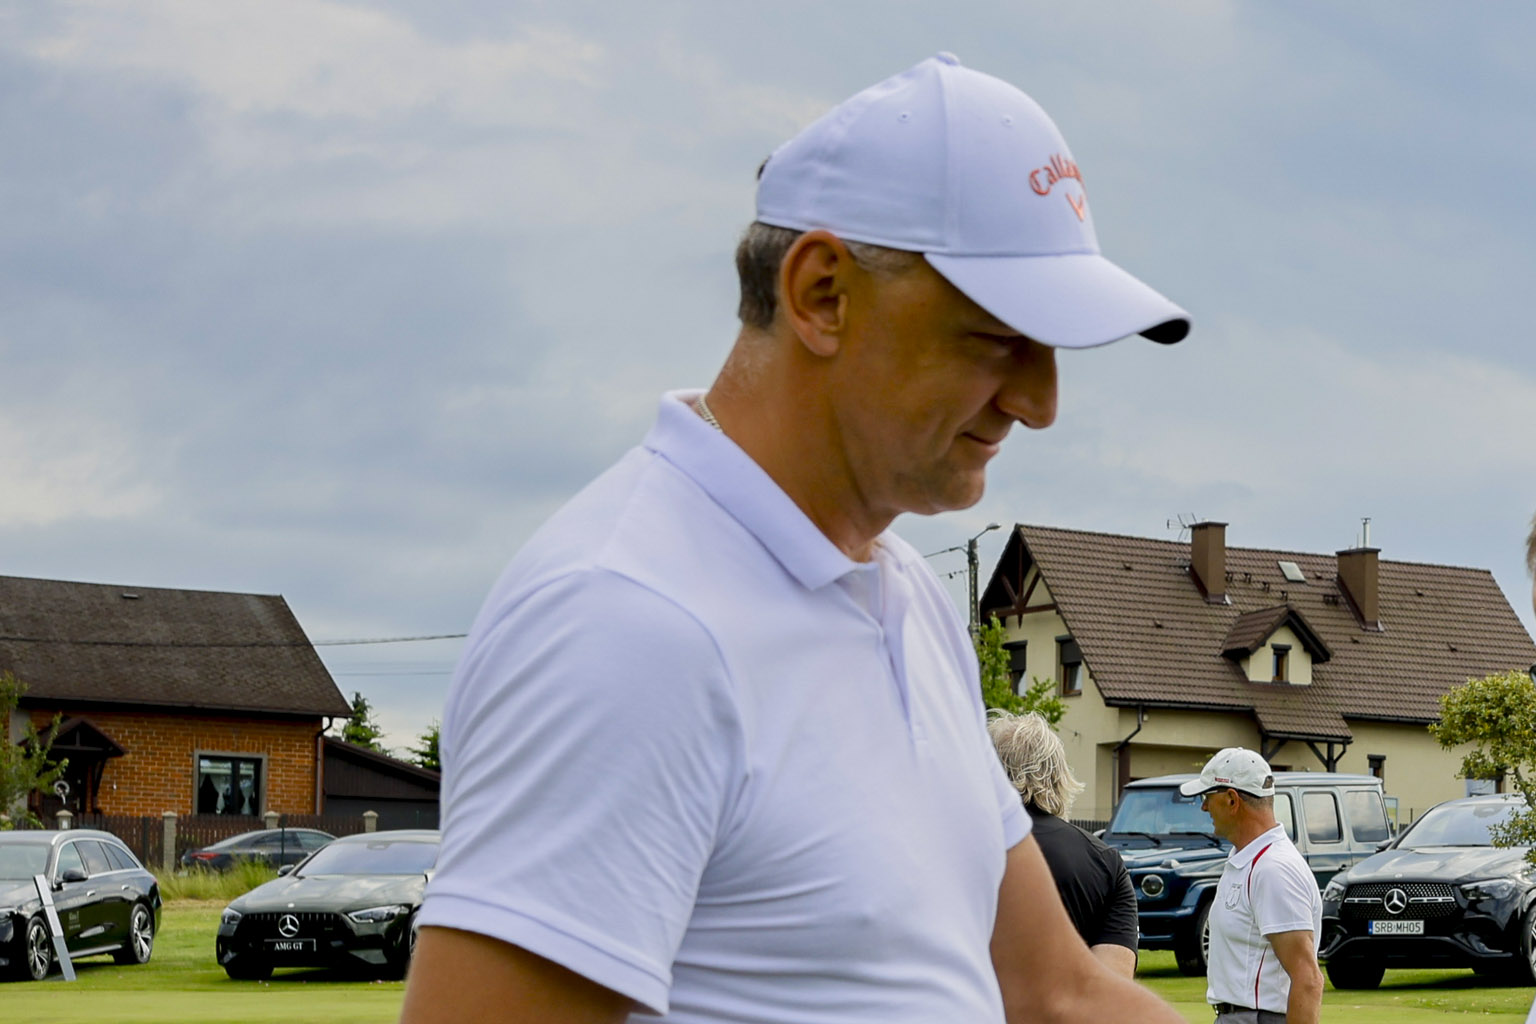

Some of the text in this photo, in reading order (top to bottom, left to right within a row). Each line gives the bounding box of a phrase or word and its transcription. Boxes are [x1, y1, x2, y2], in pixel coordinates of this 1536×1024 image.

[1375, 922, 1392, 933] SRB
[274, 942, 303, 951] AMG GT
